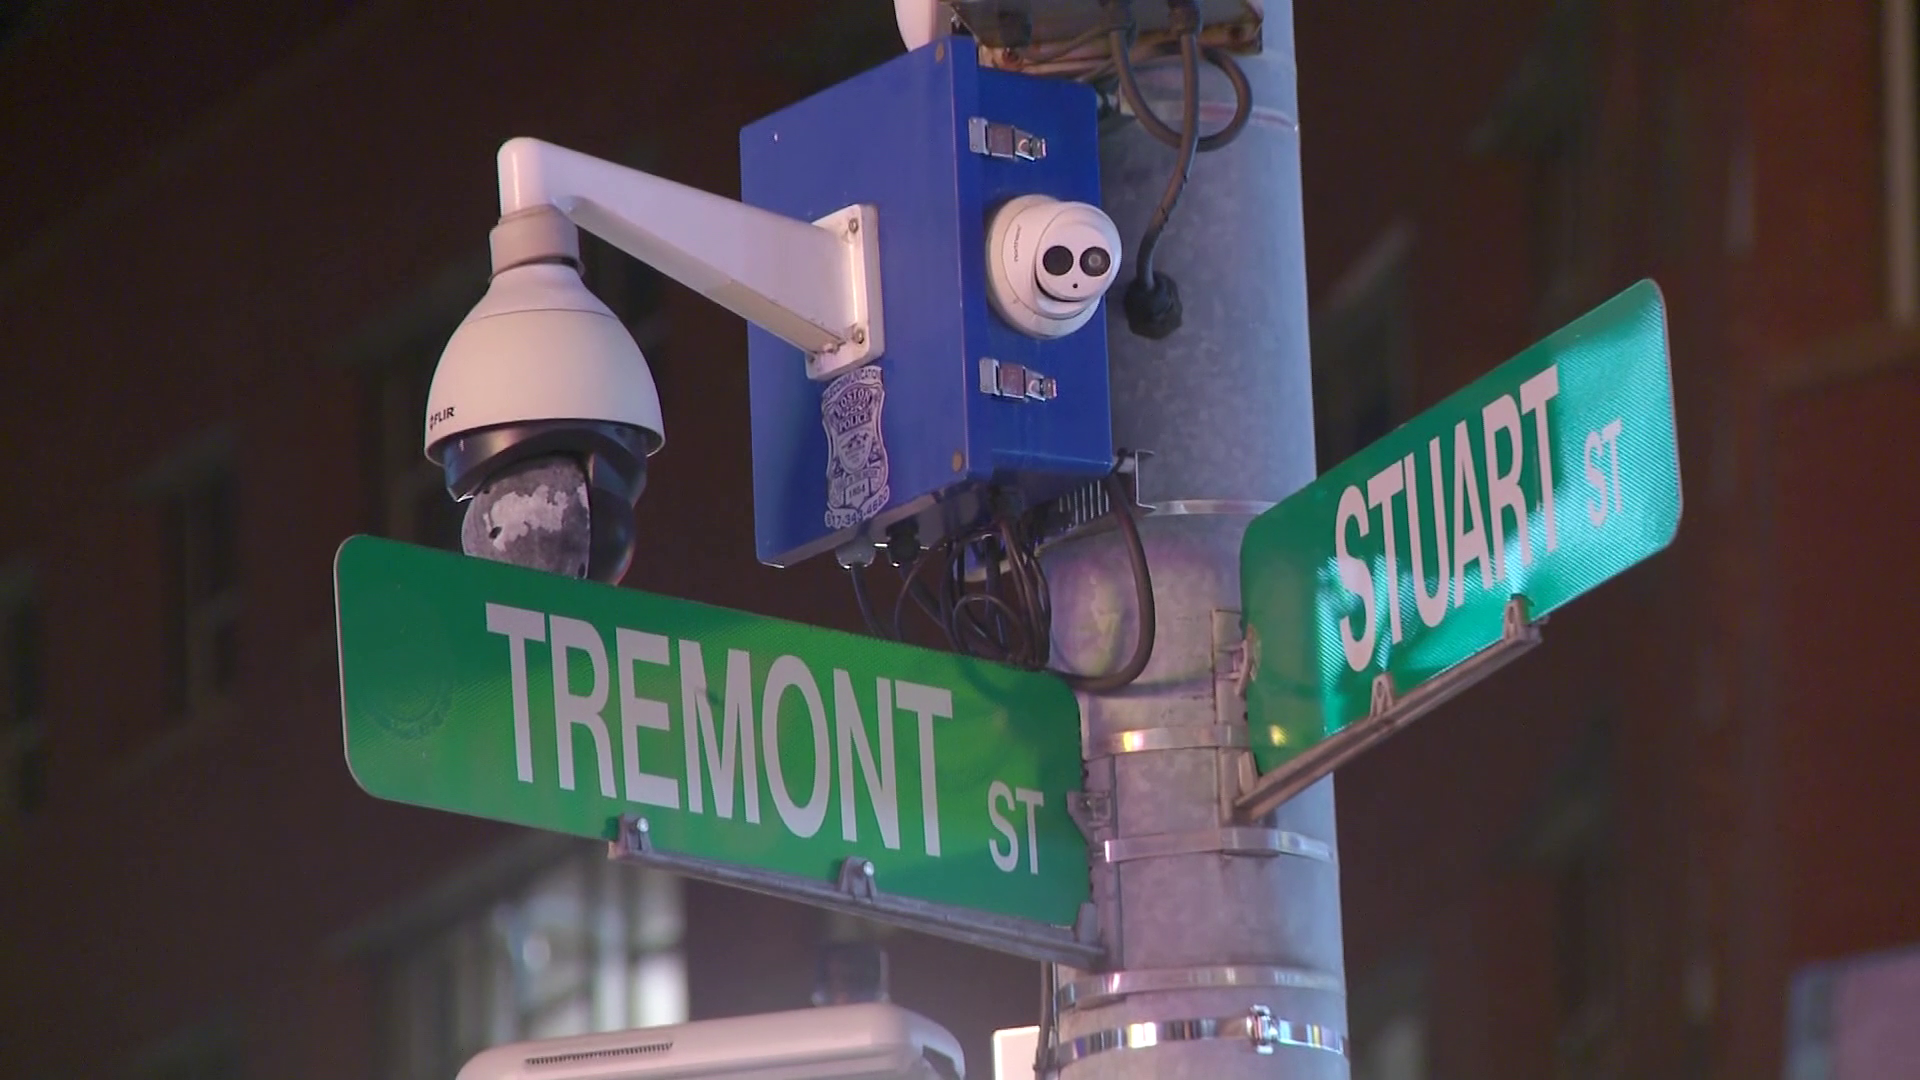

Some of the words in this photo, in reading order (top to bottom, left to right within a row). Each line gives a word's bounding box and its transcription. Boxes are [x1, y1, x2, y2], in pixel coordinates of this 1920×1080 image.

[433, 406, 455, 426] FLIR
[834, 388, 873, 418] BOSTON
[839, 411, 871, 433] POLICE
[1335, 364, 1559, 672] STUART
[1584, 418, 1622, 527] ST
[485, 602, 953, 857] TREMONT
[987, 780, 1044, 874] ST
